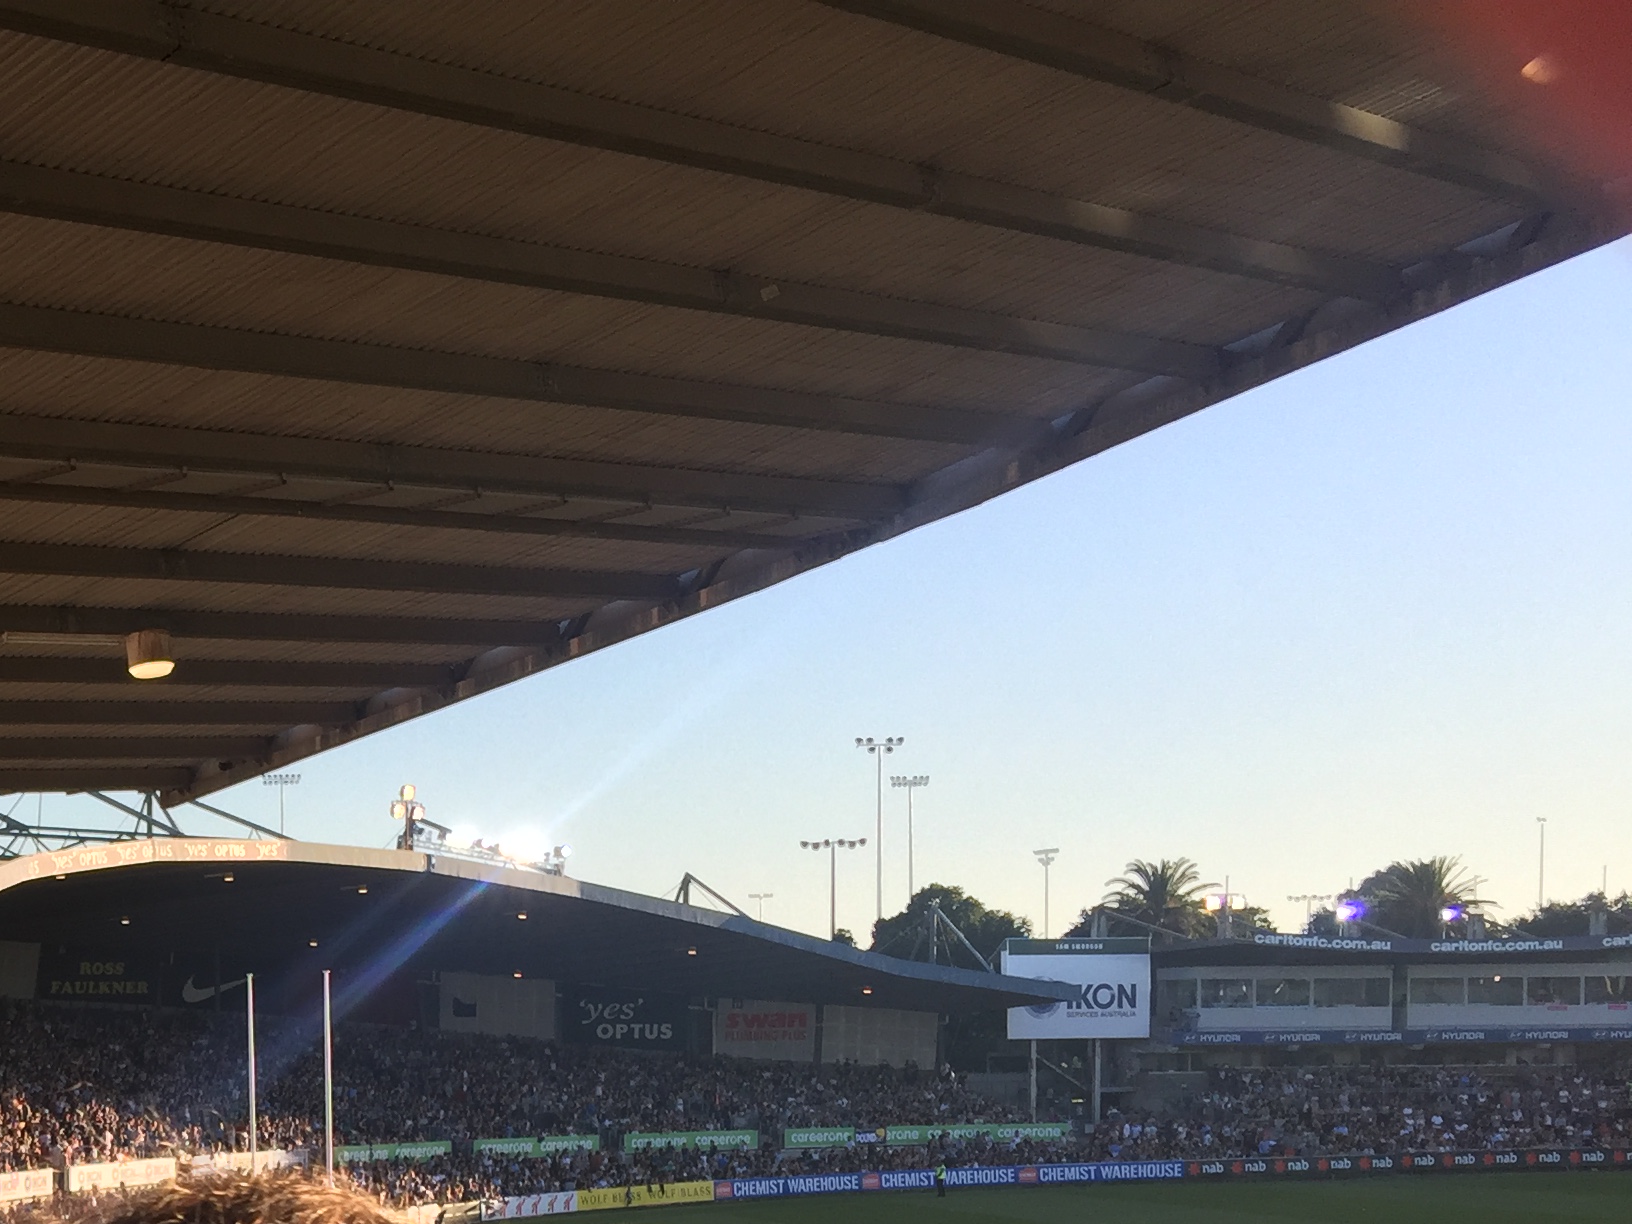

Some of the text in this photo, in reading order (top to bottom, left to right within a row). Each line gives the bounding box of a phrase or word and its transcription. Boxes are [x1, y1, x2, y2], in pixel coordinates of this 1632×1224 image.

[1254, 933, 1391, 951] carltonfc.com.au
[1430, 939, 1564, 952] carltonfc.com.au
[79, 961, 126, 977] ROSS
[50, 980, 150, 996] FAULKNER
[596, 1023, 673, 1040] OPTUS
[781, 1030, 808, 1042] PLUS
[1202, 1149, 1605, 1175] nab nab nab nab nab nab nab nab nab nab
[881, 1171, 936, 1188] CHEMIST
[942, 1168, 1015, 1185] WAREHOUSE
[1040, 1165, 1097, 1182] CHEMIST
[1100, 1163, 1182, 1180] WAREHOUSE
[734, 1178, 785, 1197] CHEMIST
[787, 1175, 859, 1194] WAREHOUSE
[580, 1195, 607, 1206] WOLF
[612, 1191, 642, 1203] BLSS
